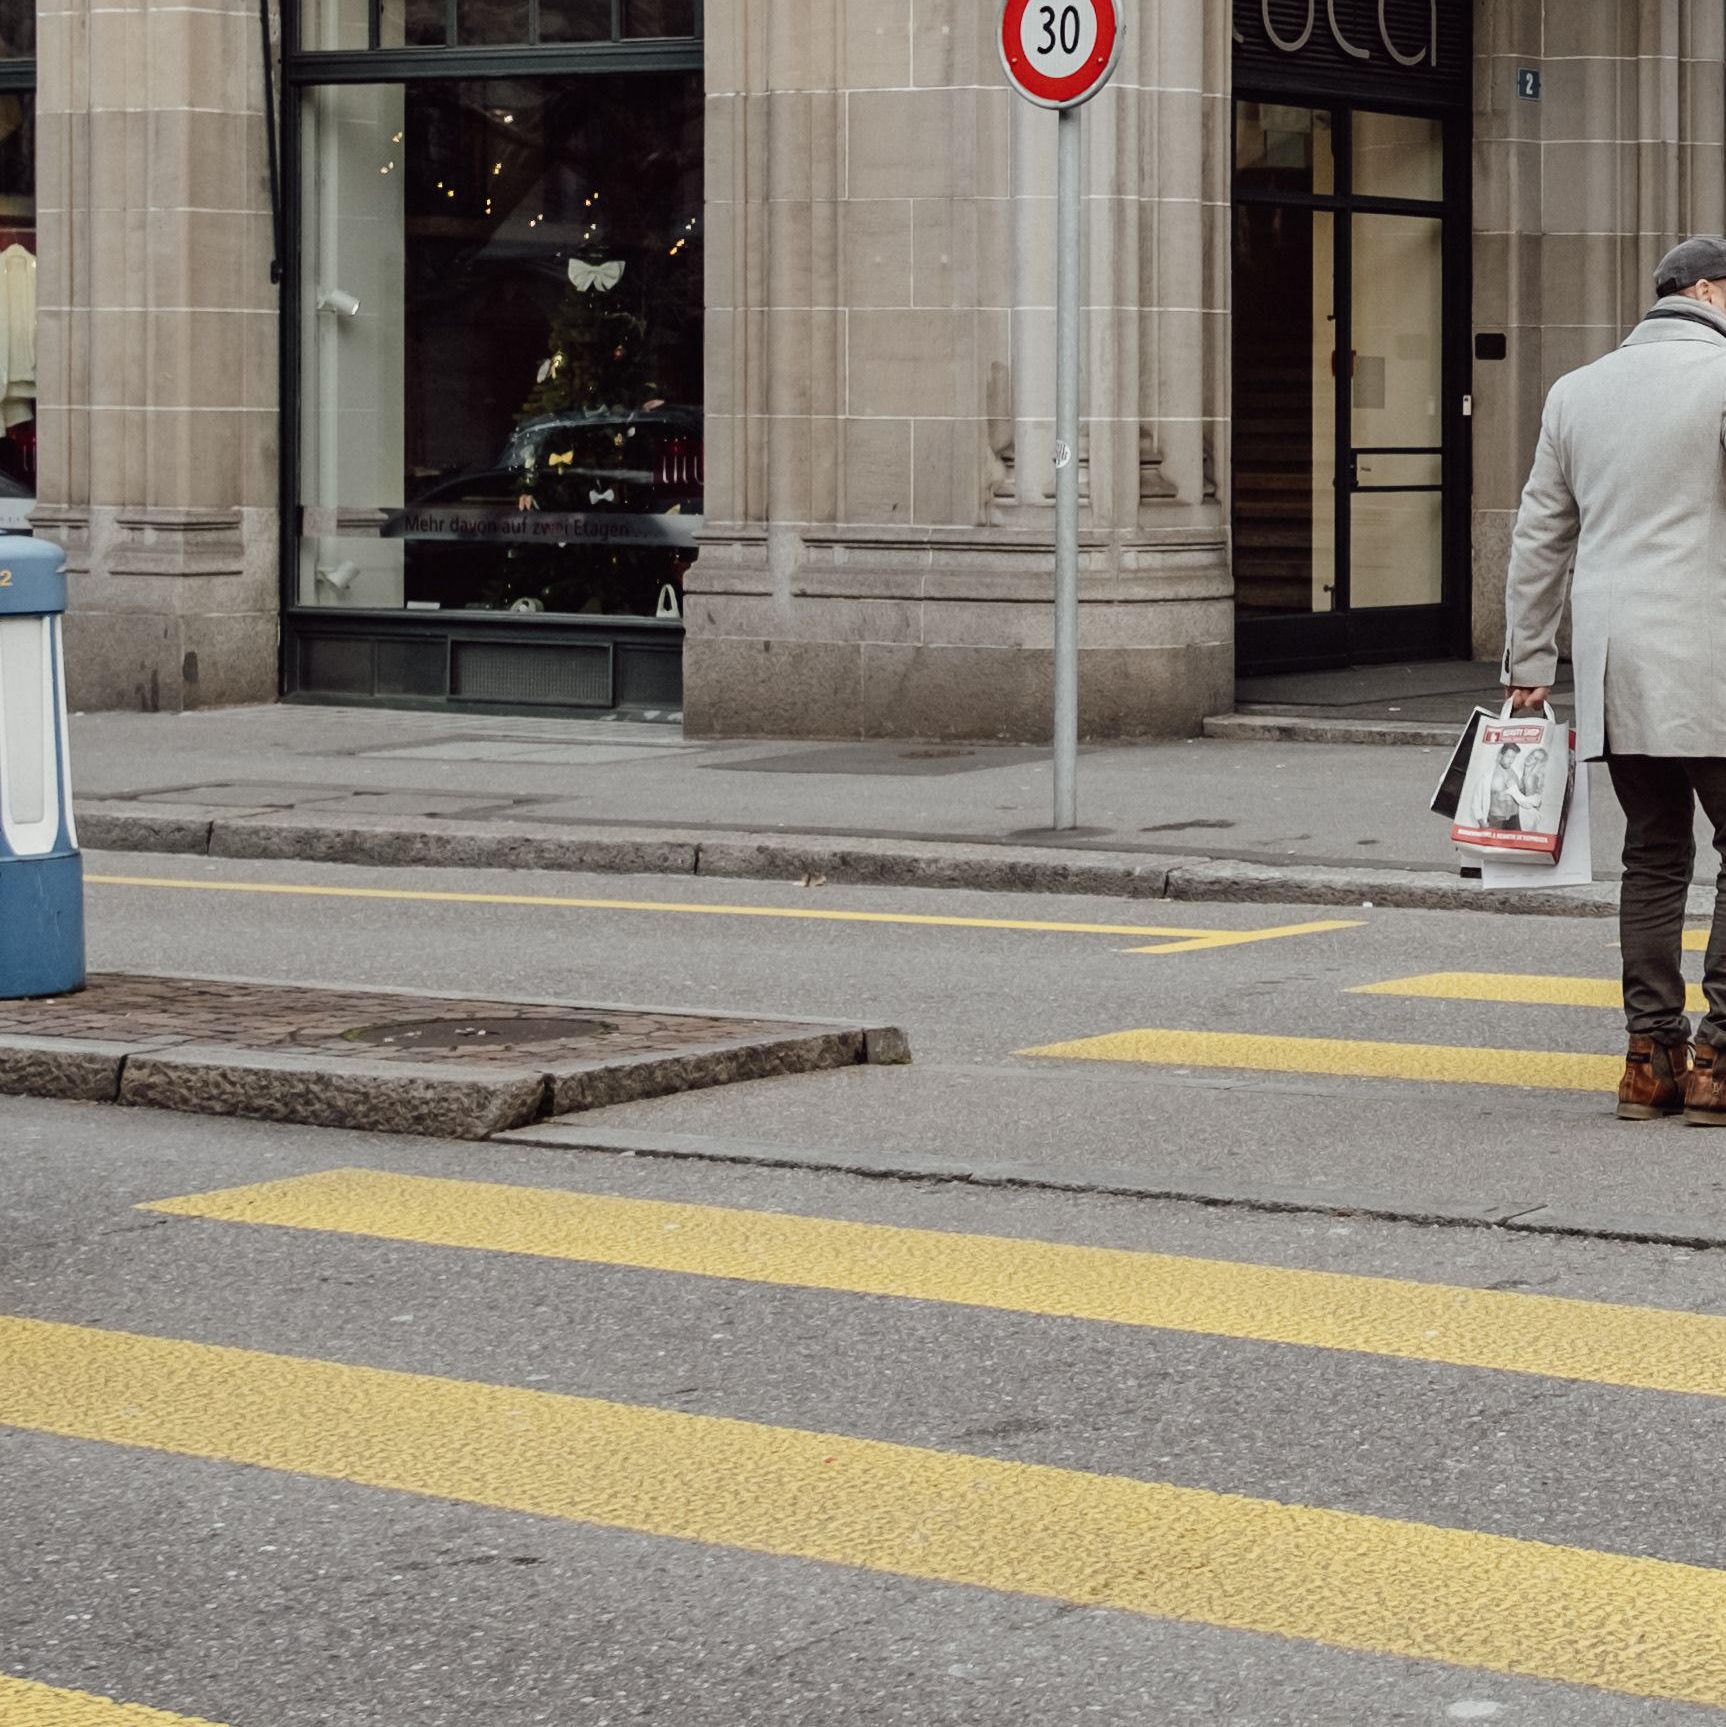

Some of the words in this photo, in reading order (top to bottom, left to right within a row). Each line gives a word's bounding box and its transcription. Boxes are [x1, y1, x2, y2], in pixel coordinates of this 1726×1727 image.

[1037, 5, 1080, 55] 30
[1525, 73, 1535, 95] 2
[404, 516, 444, 533] Mehr
[449, 517, 496, 534] davon
[502, 516, 528, 534] auf
